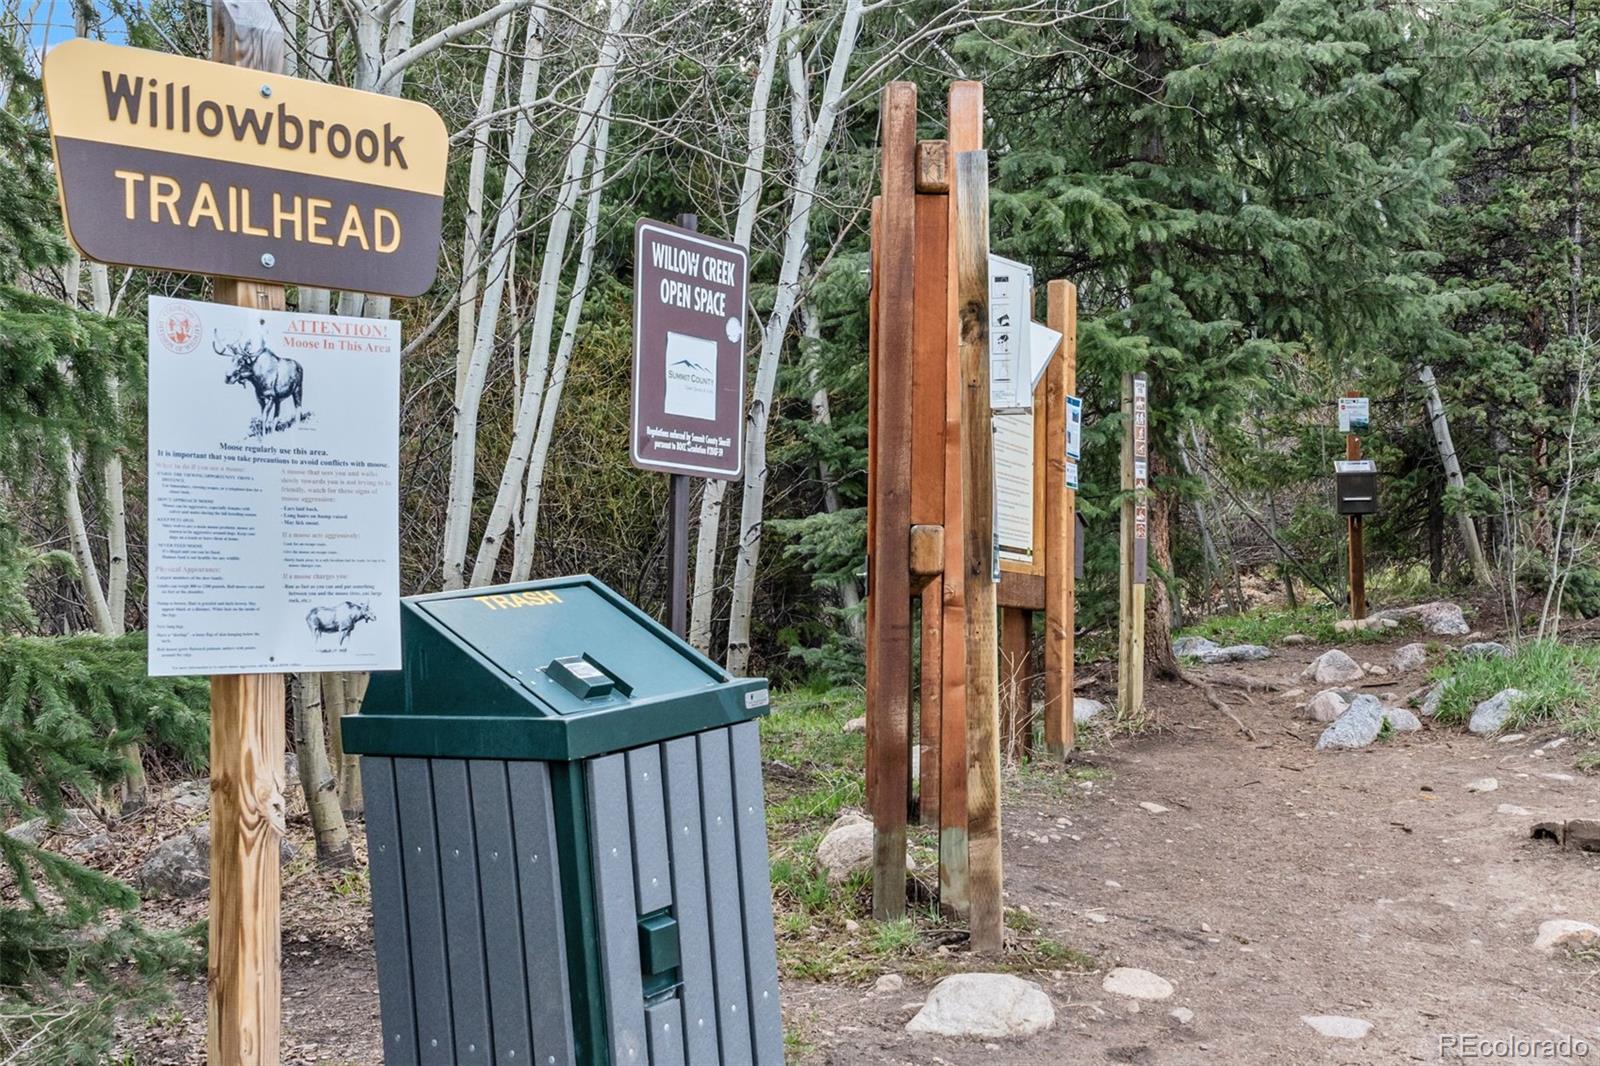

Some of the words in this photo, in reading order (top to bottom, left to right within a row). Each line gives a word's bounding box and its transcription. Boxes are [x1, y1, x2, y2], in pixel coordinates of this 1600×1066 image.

[102, 71, 408, 169] Willowbrook
[115, 170, 401, 253] TRAILHEAD
[652, 241, 700, 277] WILLOW
[702, 256, 735, 287] CREEK
[661, 278, 691, 309] OPEN
[694, 286, 726, 317] SPACE
[288, 320, 387, 337] ATTENTION!
[284, 336, 319, 349] Moose
[323, 339, 335, 349] In
[340, 340, 362, 351] This
[366, 342, 390, 352] Area
[220, 442, 243, 451] Moose
[245, 445, 276, 453] regularly
[173, 451, 207, 459] important
[253, 456, 289, 464] precautions
[321, 459, 348, 467] conflicts
[474, 590, 563, 610] TRASH
